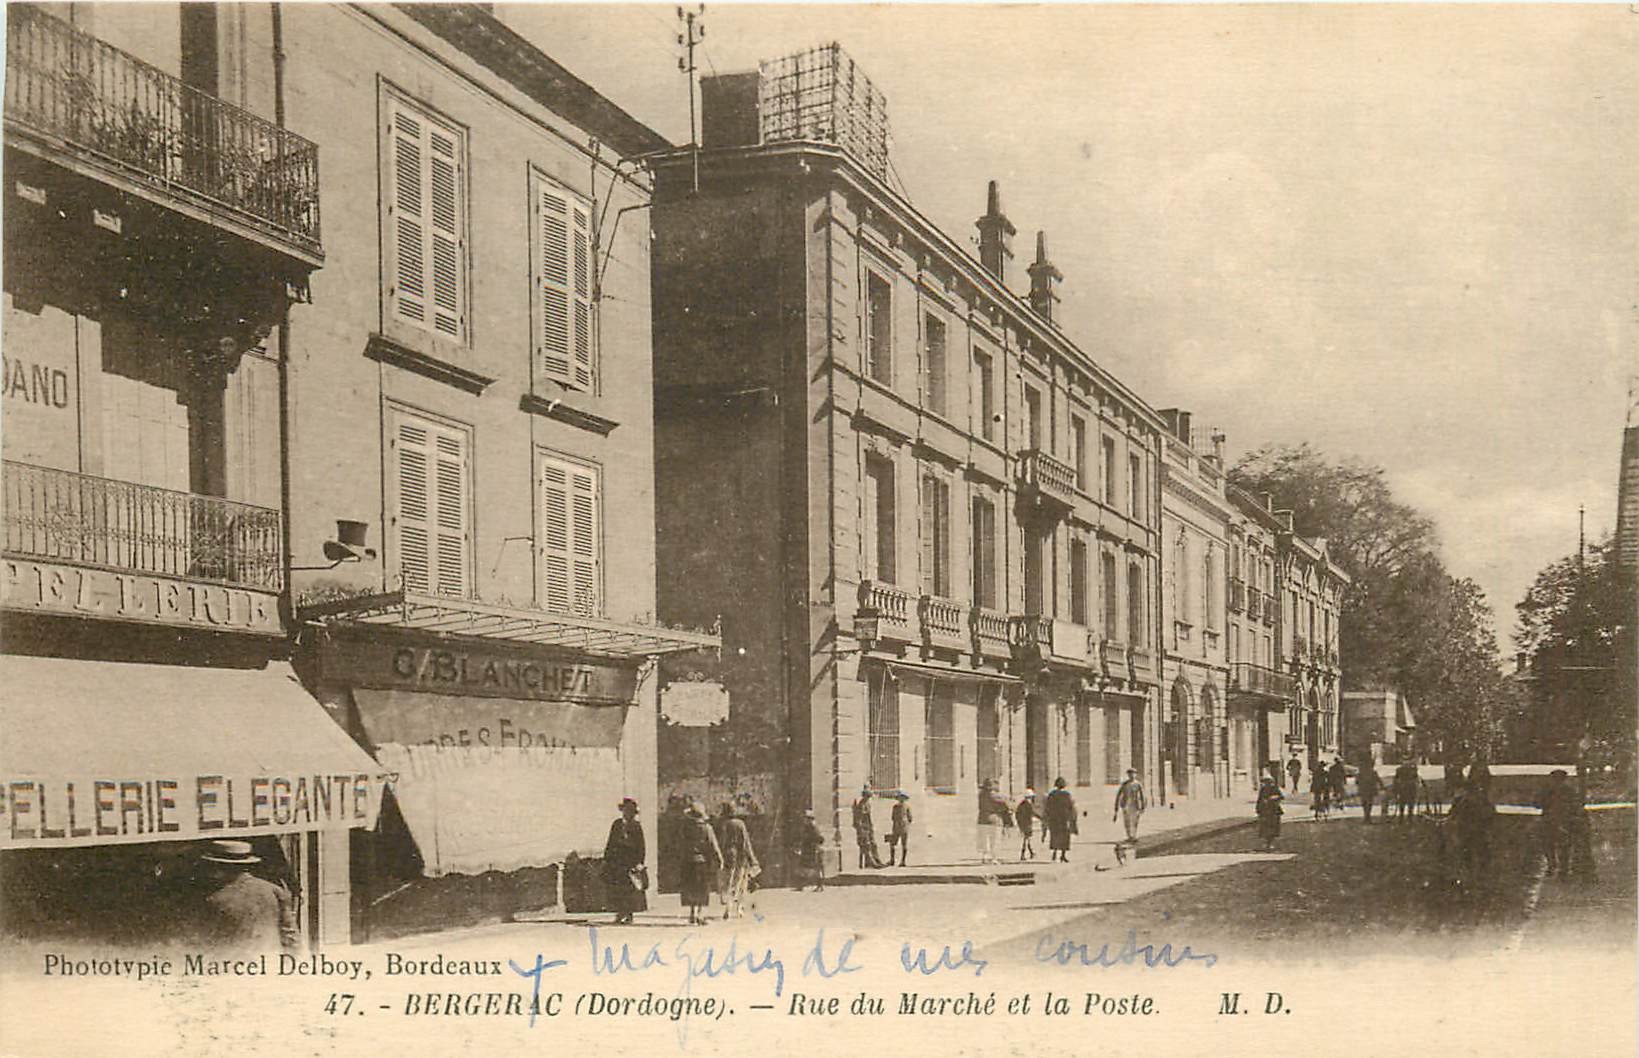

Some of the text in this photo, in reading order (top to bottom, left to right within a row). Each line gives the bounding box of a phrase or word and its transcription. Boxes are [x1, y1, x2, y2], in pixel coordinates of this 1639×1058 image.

[0, 774, 369, 839] ELLERIE ELEGANTE
[802, 928, 863, 978] de
